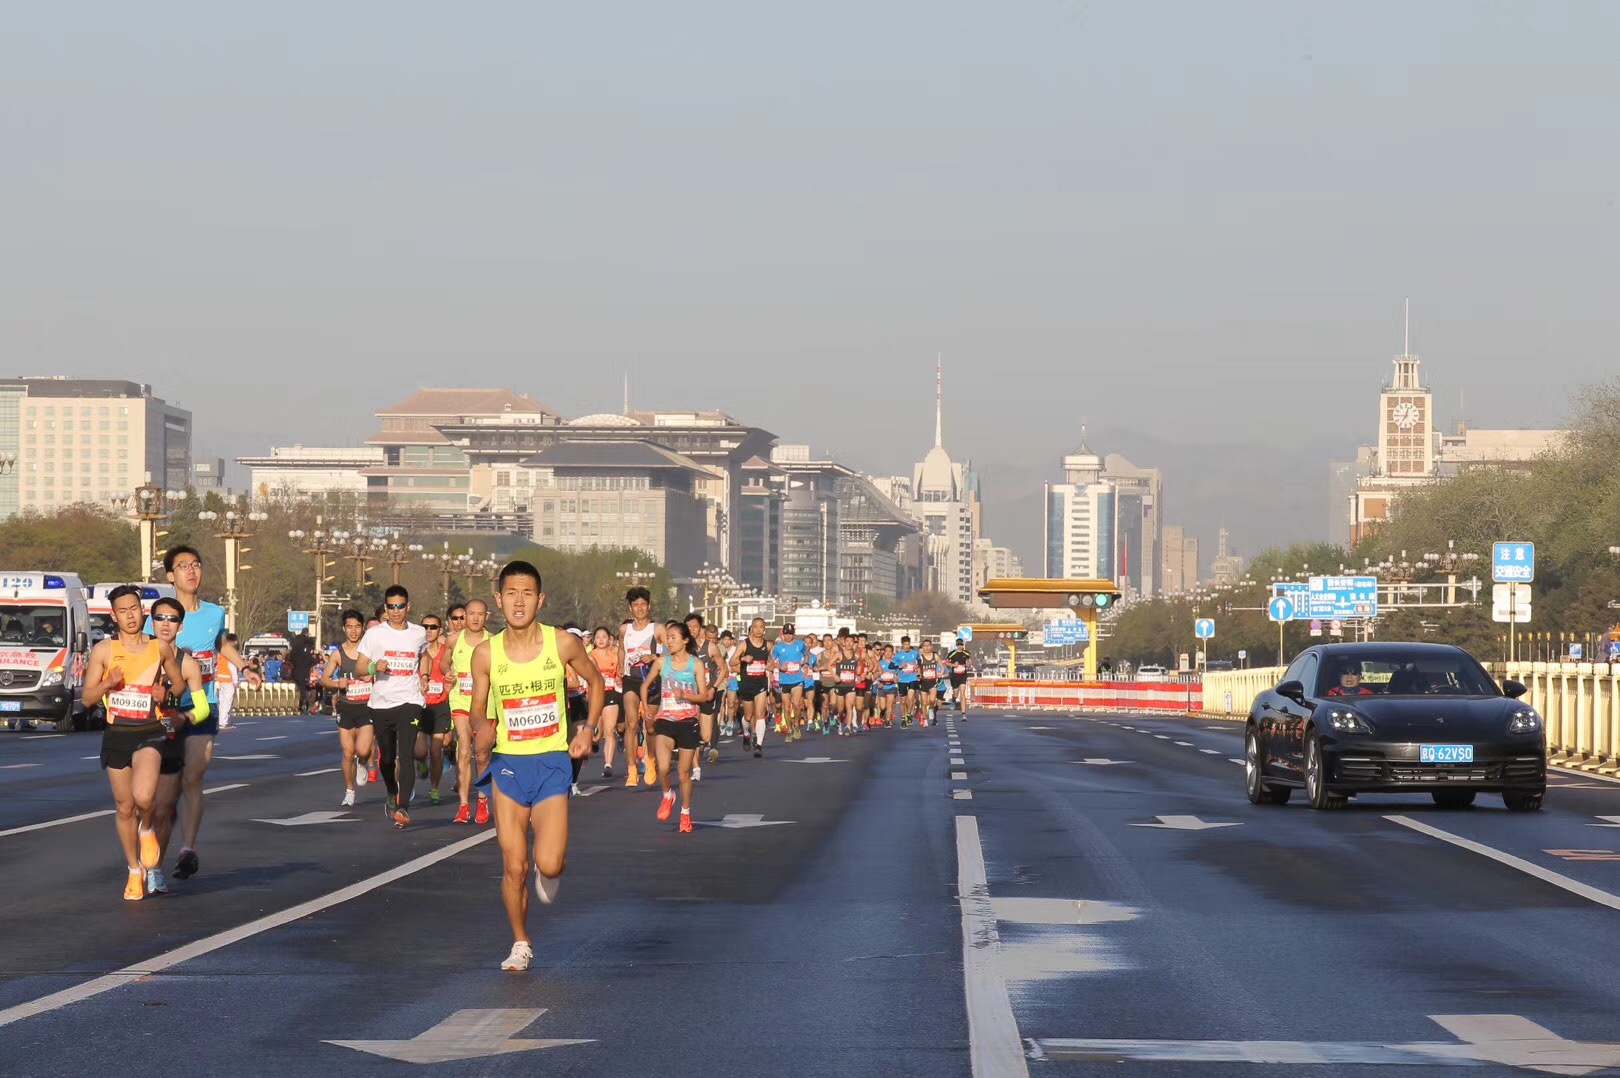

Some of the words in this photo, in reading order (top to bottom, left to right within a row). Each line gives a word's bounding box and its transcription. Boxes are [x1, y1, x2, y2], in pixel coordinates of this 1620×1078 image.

[1501, 548, 1525, 560] 注意
[1495, 564, 1531, 578] 交通安全
[111, 697, 148, 708] M09360
[509, 711, 556, 727] M06026
